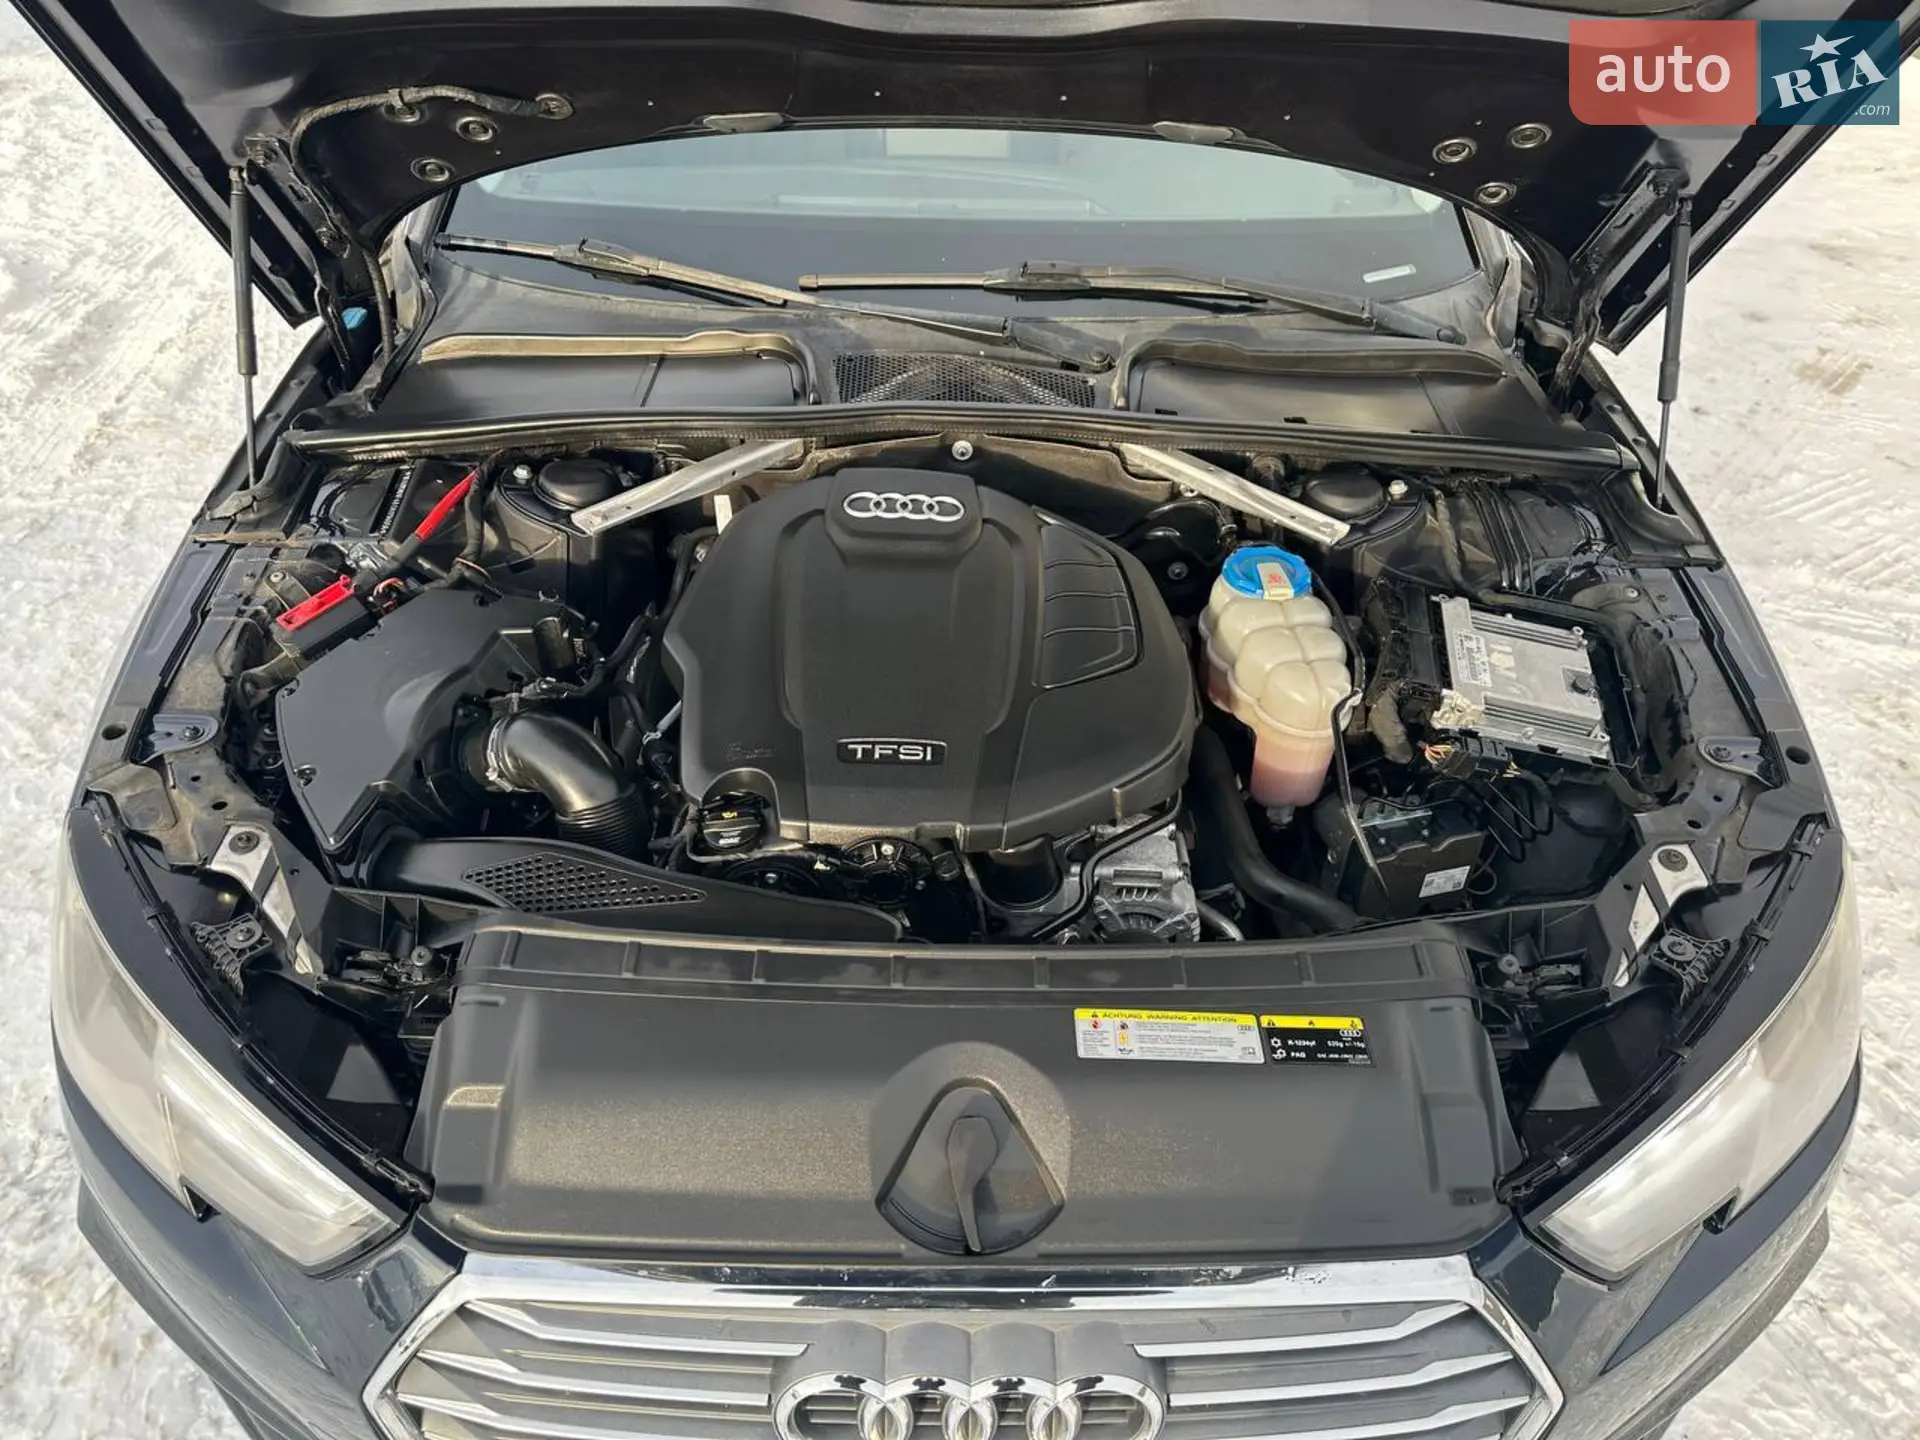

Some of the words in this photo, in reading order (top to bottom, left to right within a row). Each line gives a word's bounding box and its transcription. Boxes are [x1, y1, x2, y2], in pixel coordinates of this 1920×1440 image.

[847, 744, 932, 761] TFSI
[1102, 1011, 1142, 1019] ACHTUNG
[1147, 1013, 1188, 1021] WARNING
